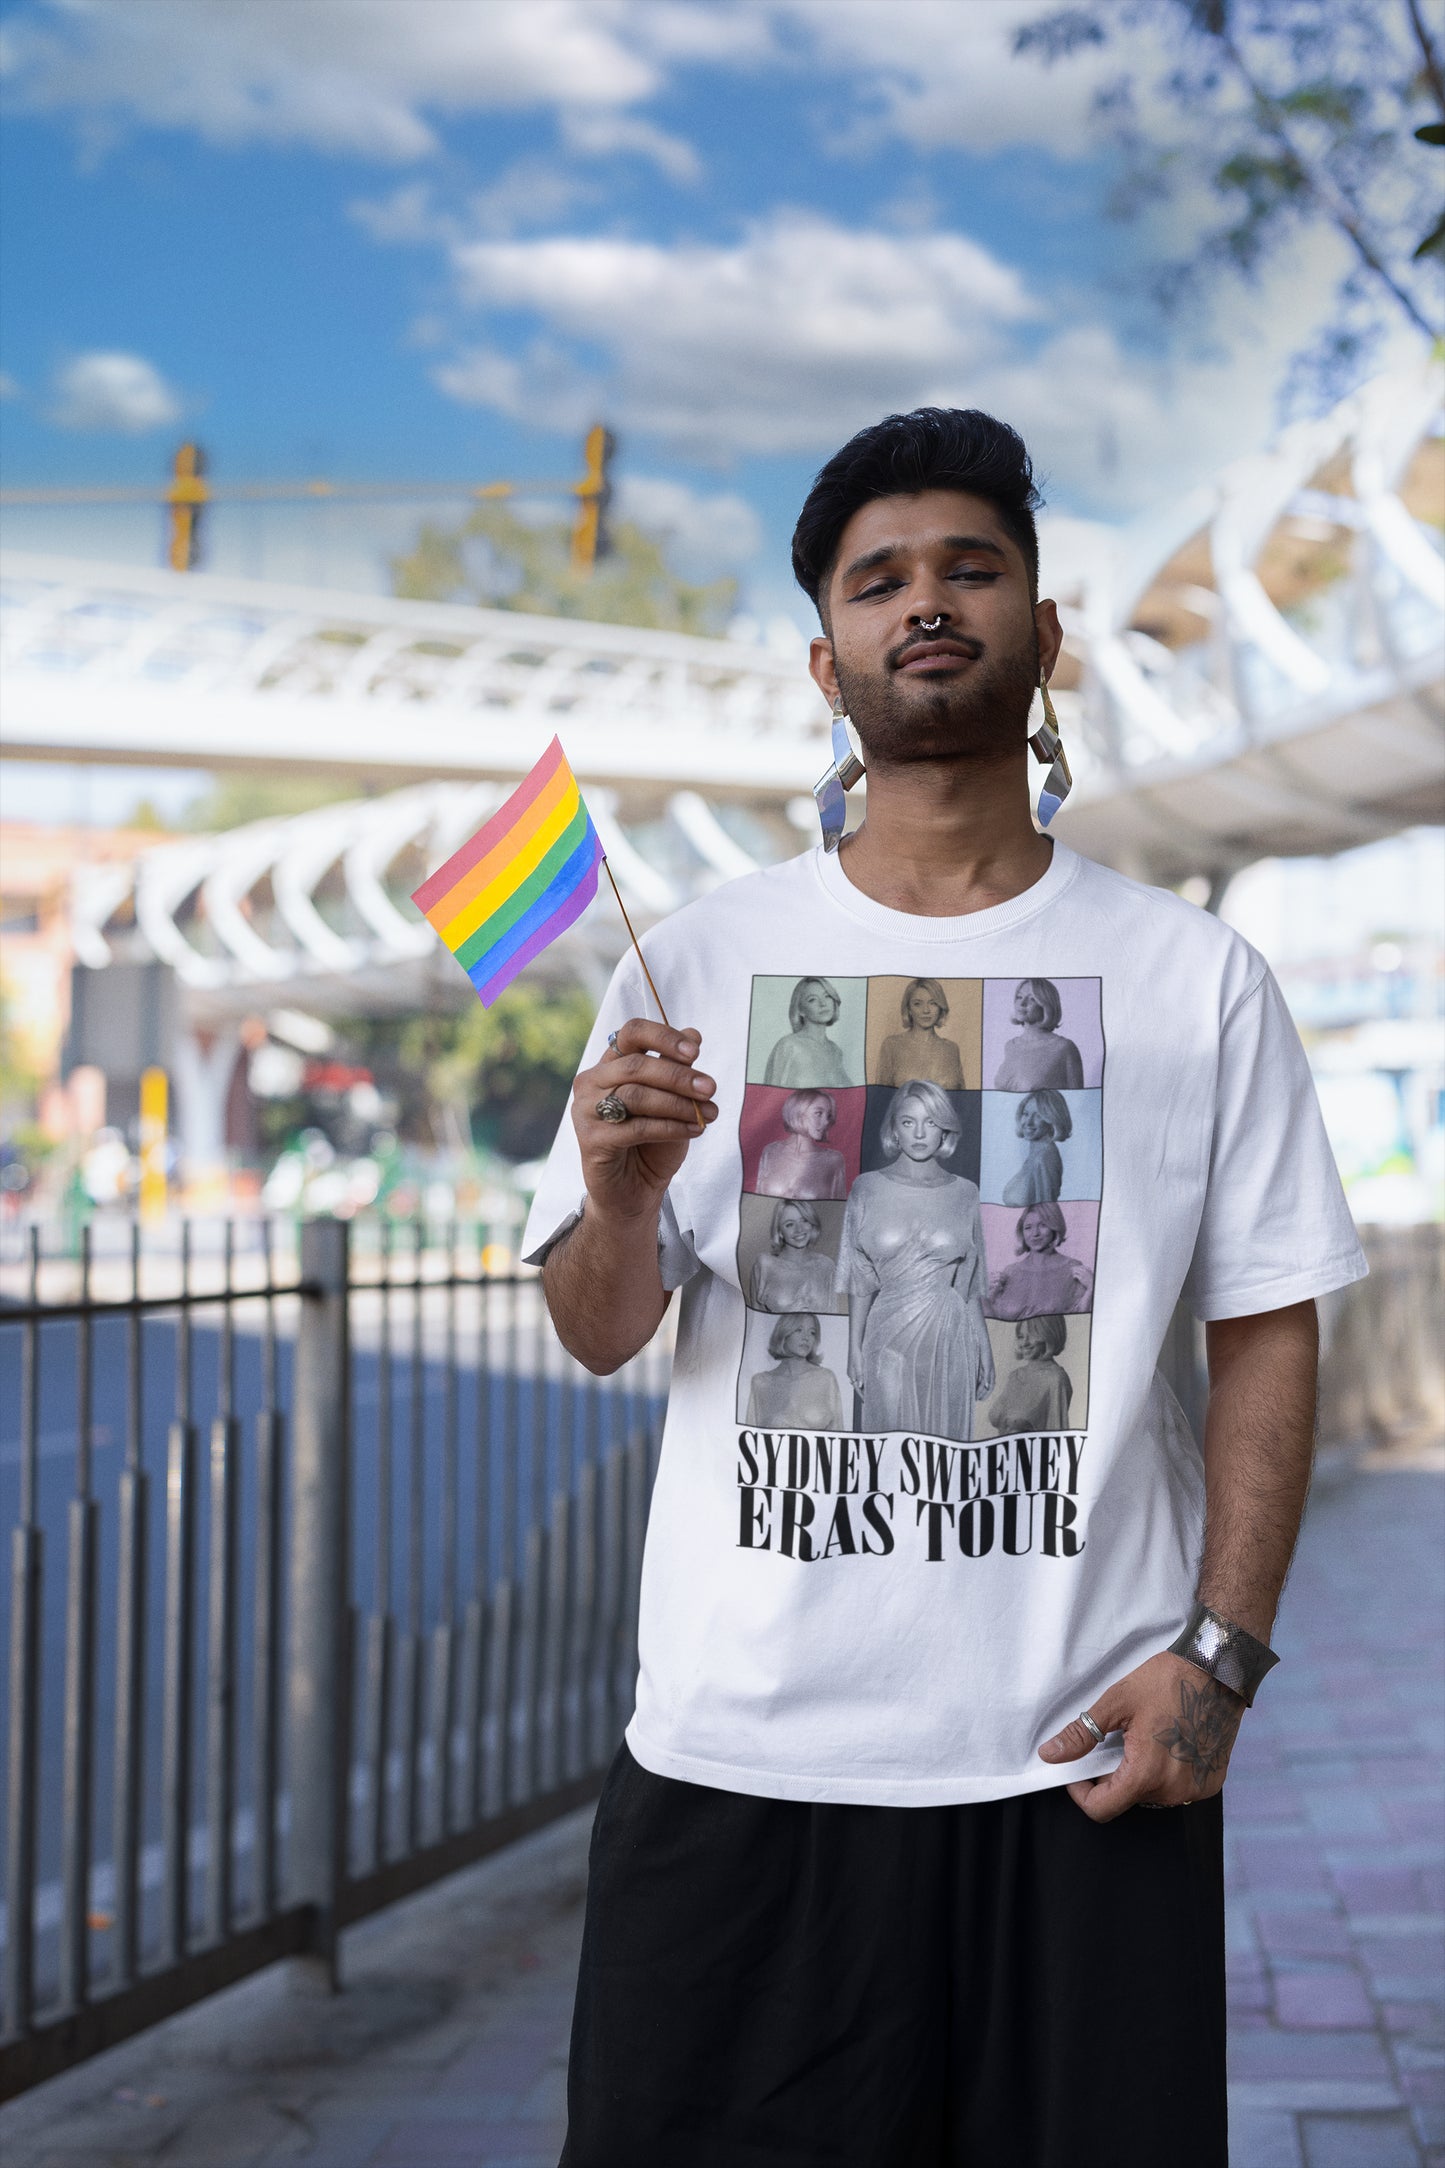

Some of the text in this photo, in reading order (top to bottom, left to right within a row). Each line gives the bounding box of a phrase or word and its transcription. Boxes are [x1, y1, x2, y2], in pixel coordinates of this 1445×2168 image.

[737, 1430, 1088, 1502] SYDNEY SWEENEY
[736, 1485, 1086, 1562] ERAS TOUR
